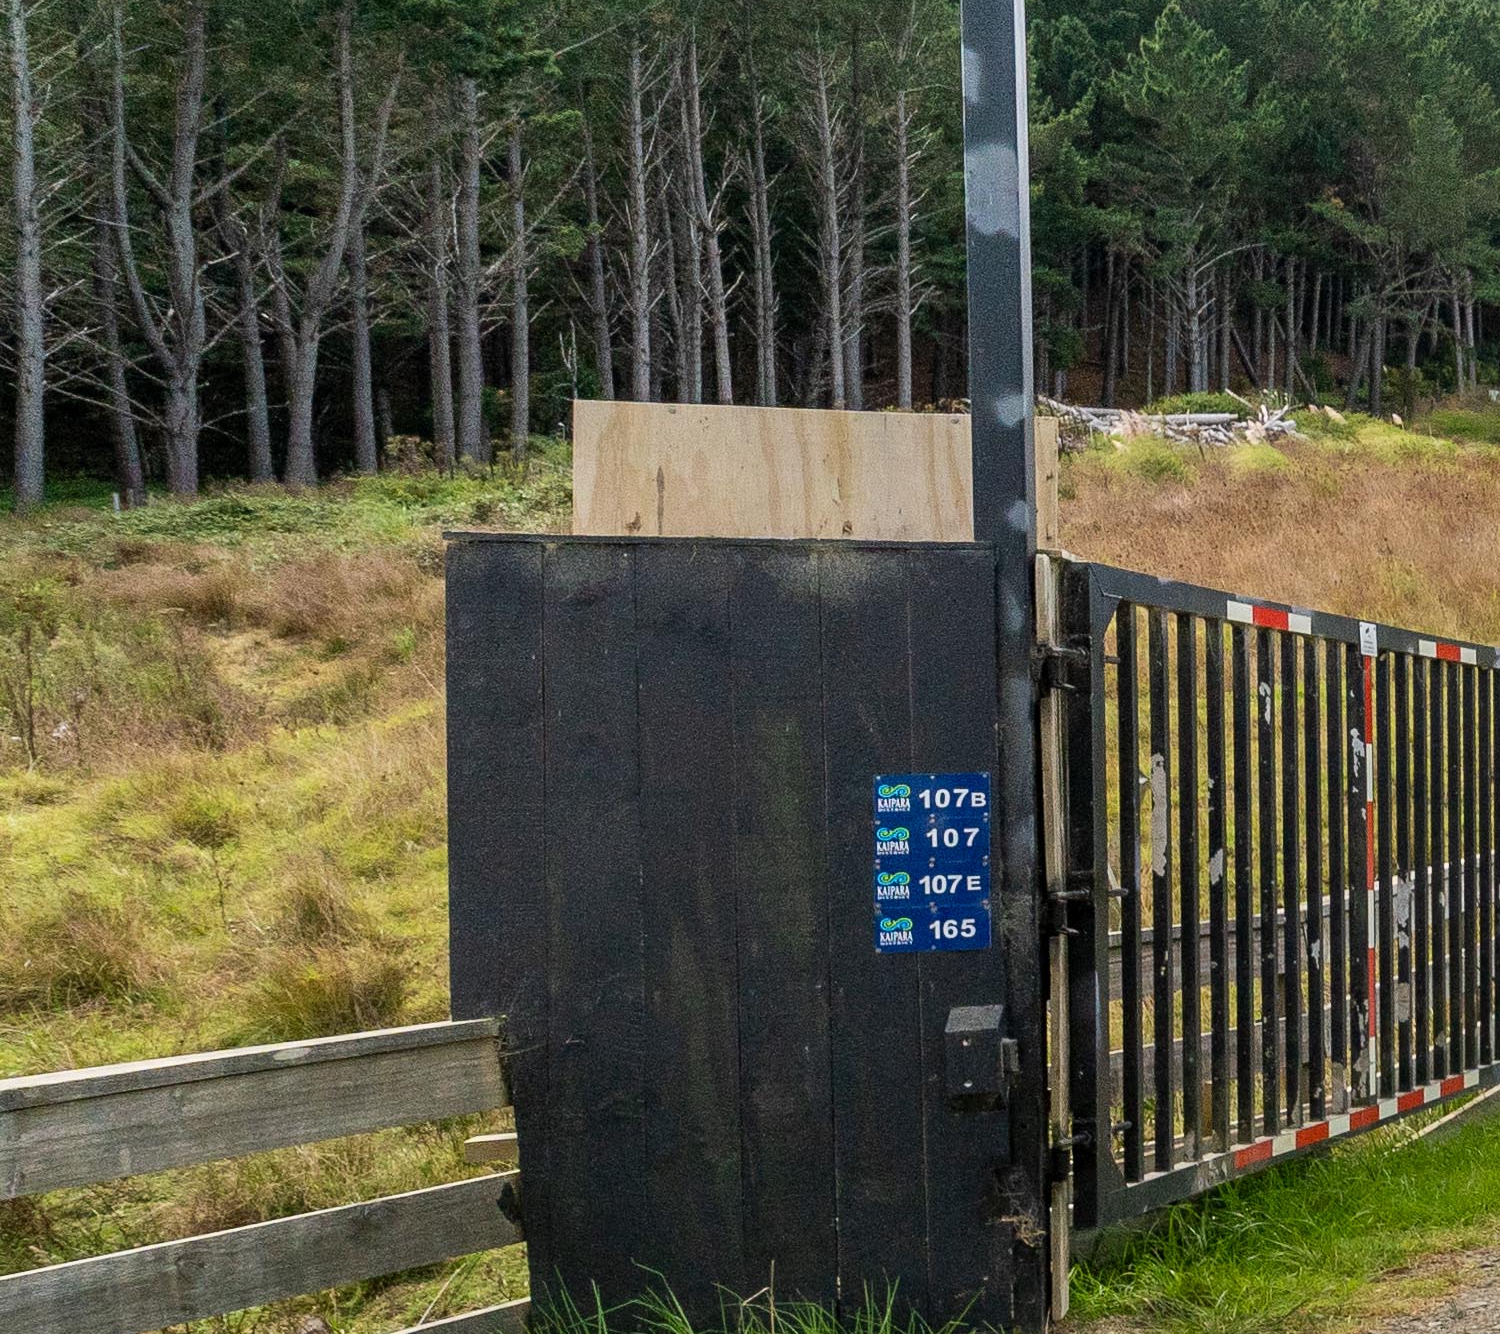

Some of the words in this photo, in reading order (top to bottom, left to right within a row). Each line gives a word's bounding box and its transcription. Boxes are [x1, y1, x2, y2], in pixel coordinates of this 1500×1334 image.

[877, 798, 911, 808] KAIPARA
[918, 788, 987, 808] 107B
[926, 828, 980, 848] 107
[876, 841, 909, 851] KAIPARA
[877, 885, 910, 896] KAIPARA
[918, 875, 982, 895] 107E
[880, 931, 913, 941] KAIPARA
[929, 918, 976, 939] 165
